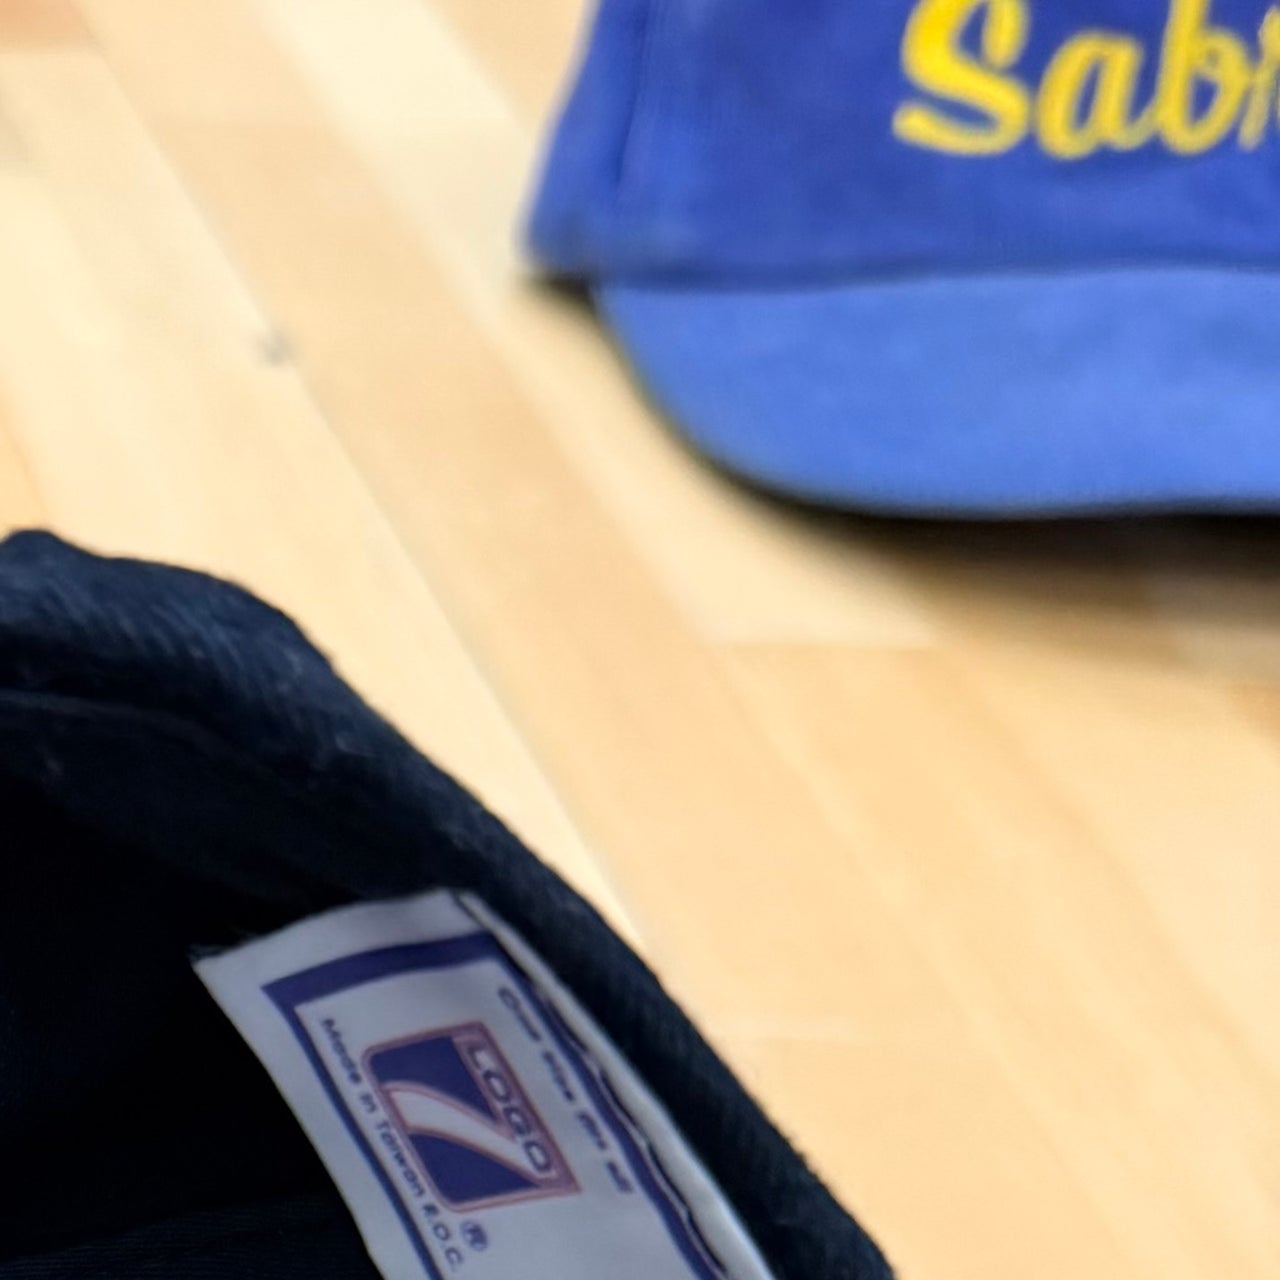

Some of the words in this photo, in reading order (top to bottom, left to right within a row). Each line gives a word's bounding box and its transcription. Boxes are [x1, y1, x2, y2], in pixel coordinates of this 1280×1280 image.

[322, 1018, 361, 1085] Made
[376, 1120, 425, 1199] Taiwan
[467, 1046, 551, 1174] LOGO
